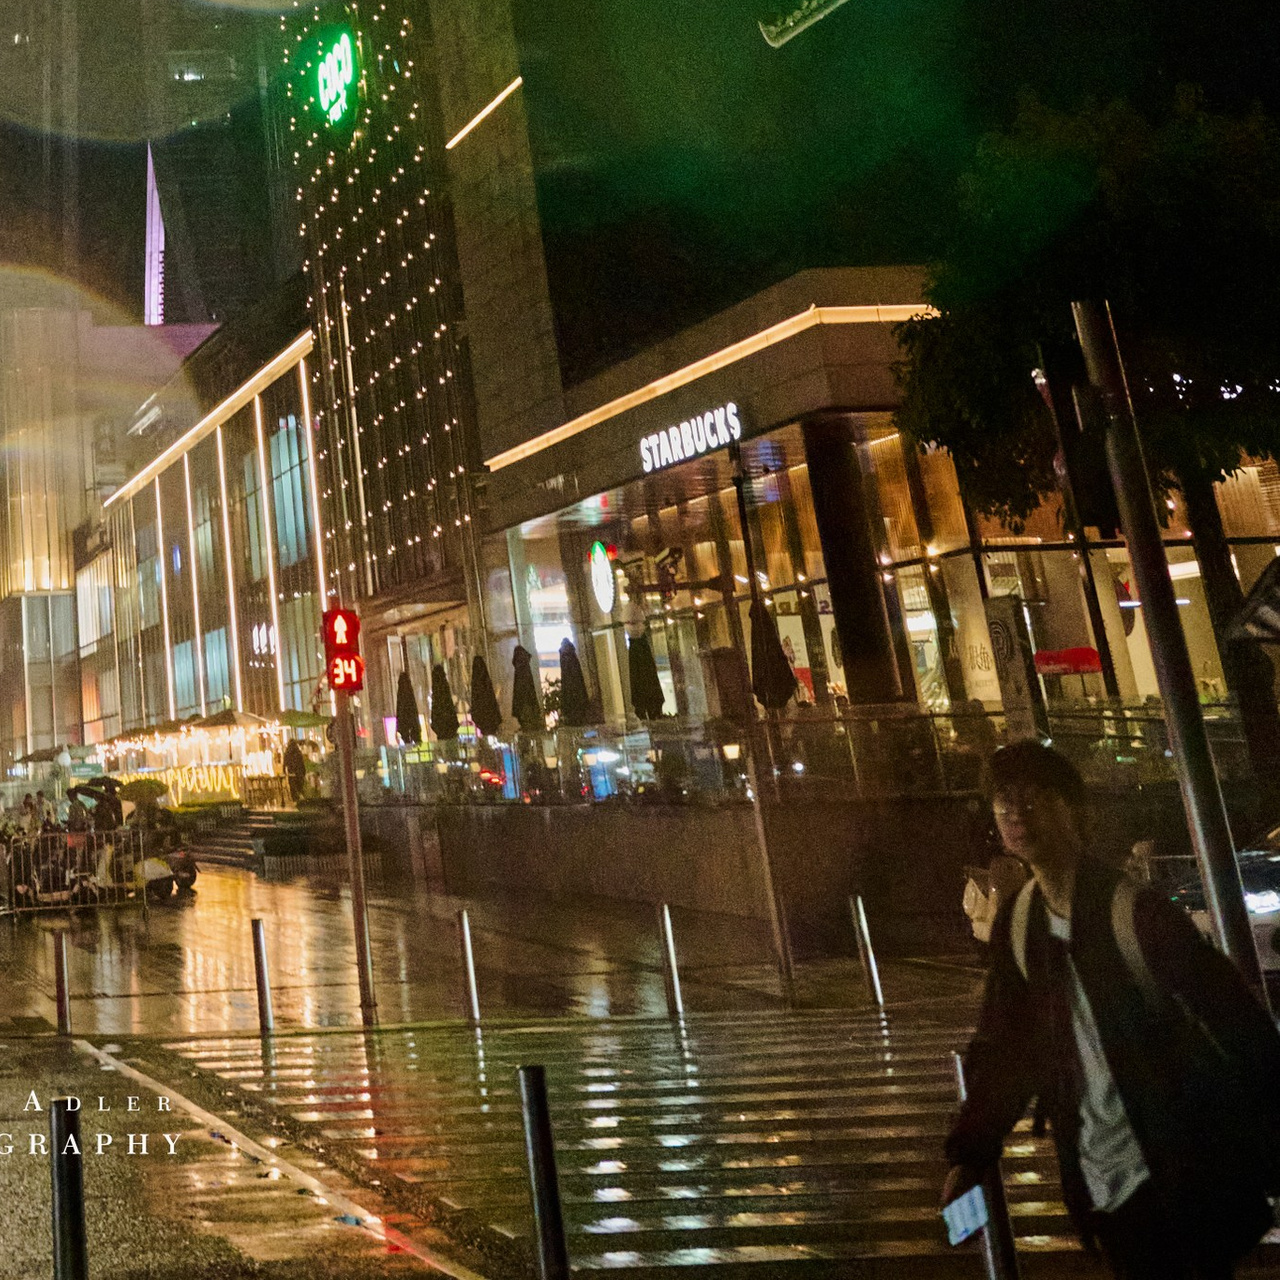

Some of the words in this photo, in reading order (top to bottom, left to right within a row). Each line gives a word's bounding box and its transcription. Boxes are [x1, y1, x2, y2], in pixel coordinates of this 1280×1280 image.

[317, 32, 353, 112] COCO
[639, 401, 742, 474] STARBUCKS
[333, 657, 358, 684] 34
